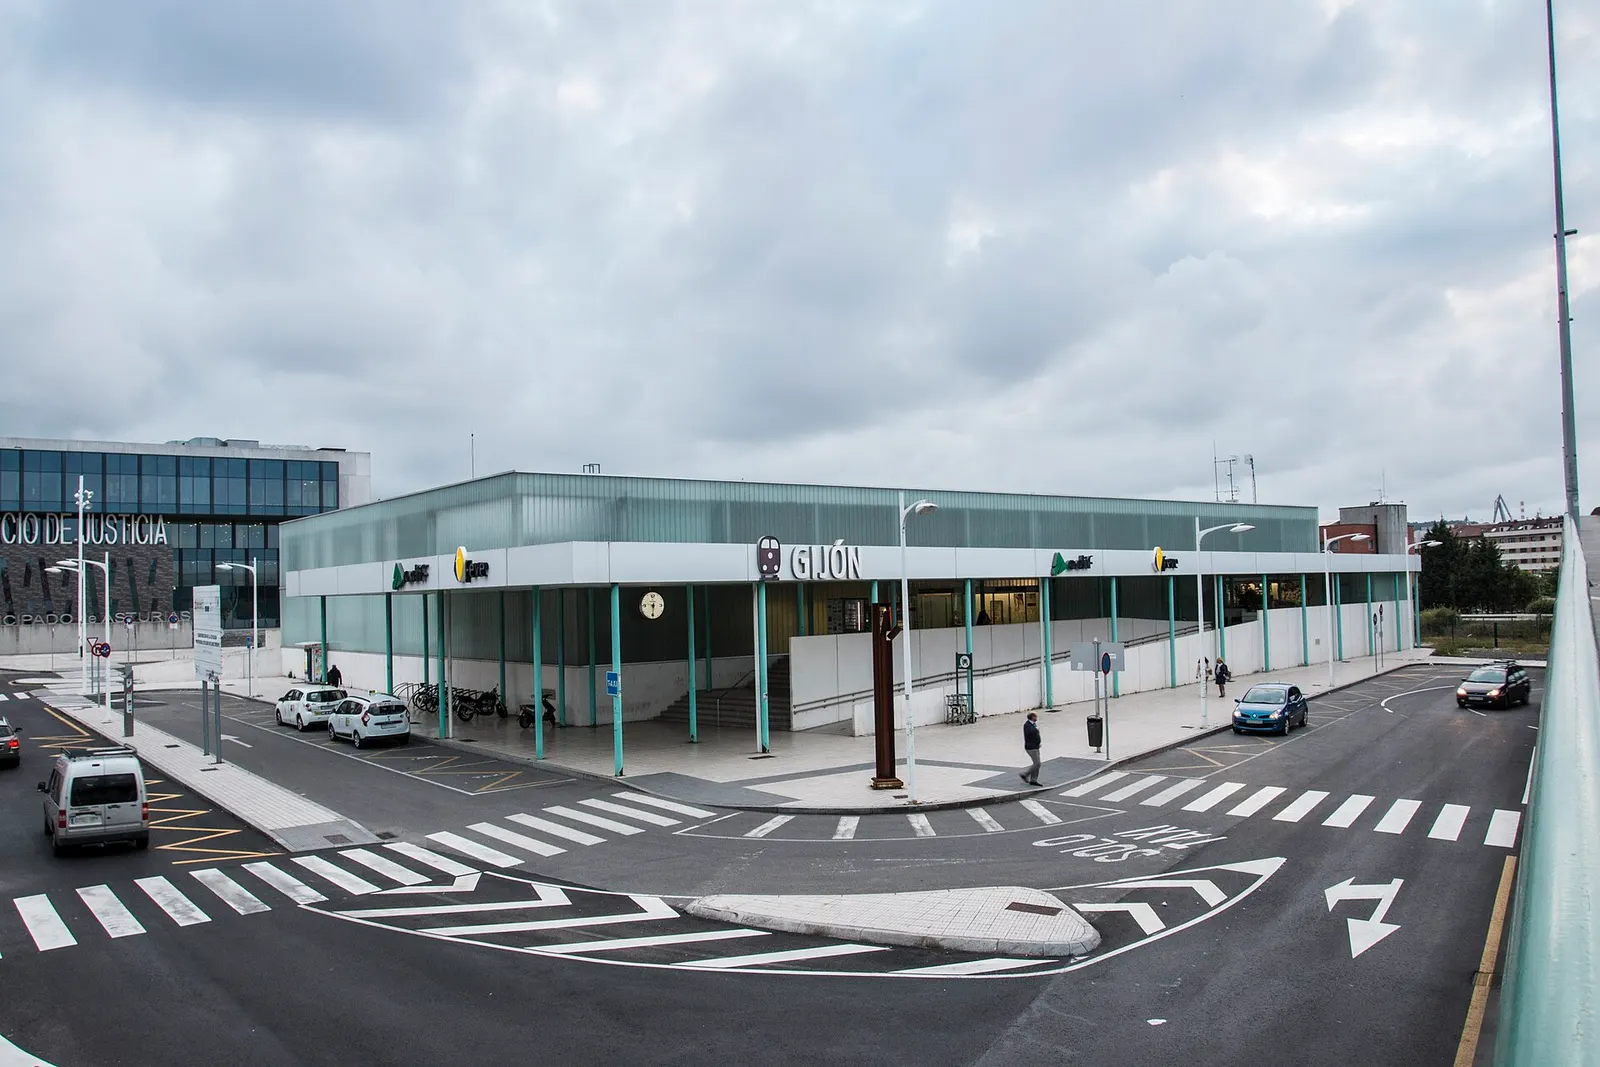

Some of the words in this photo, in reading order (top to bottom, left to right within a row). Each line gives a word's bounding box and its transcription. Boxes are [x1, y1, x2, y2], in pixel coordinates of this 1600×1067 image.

[46, 513, 73, 545] DE
[82, 514, 168, 545] JUSTICIA
[791, 538, 862, 580] GIJÓN
[1112, 824, 1229, 850] TAXI
